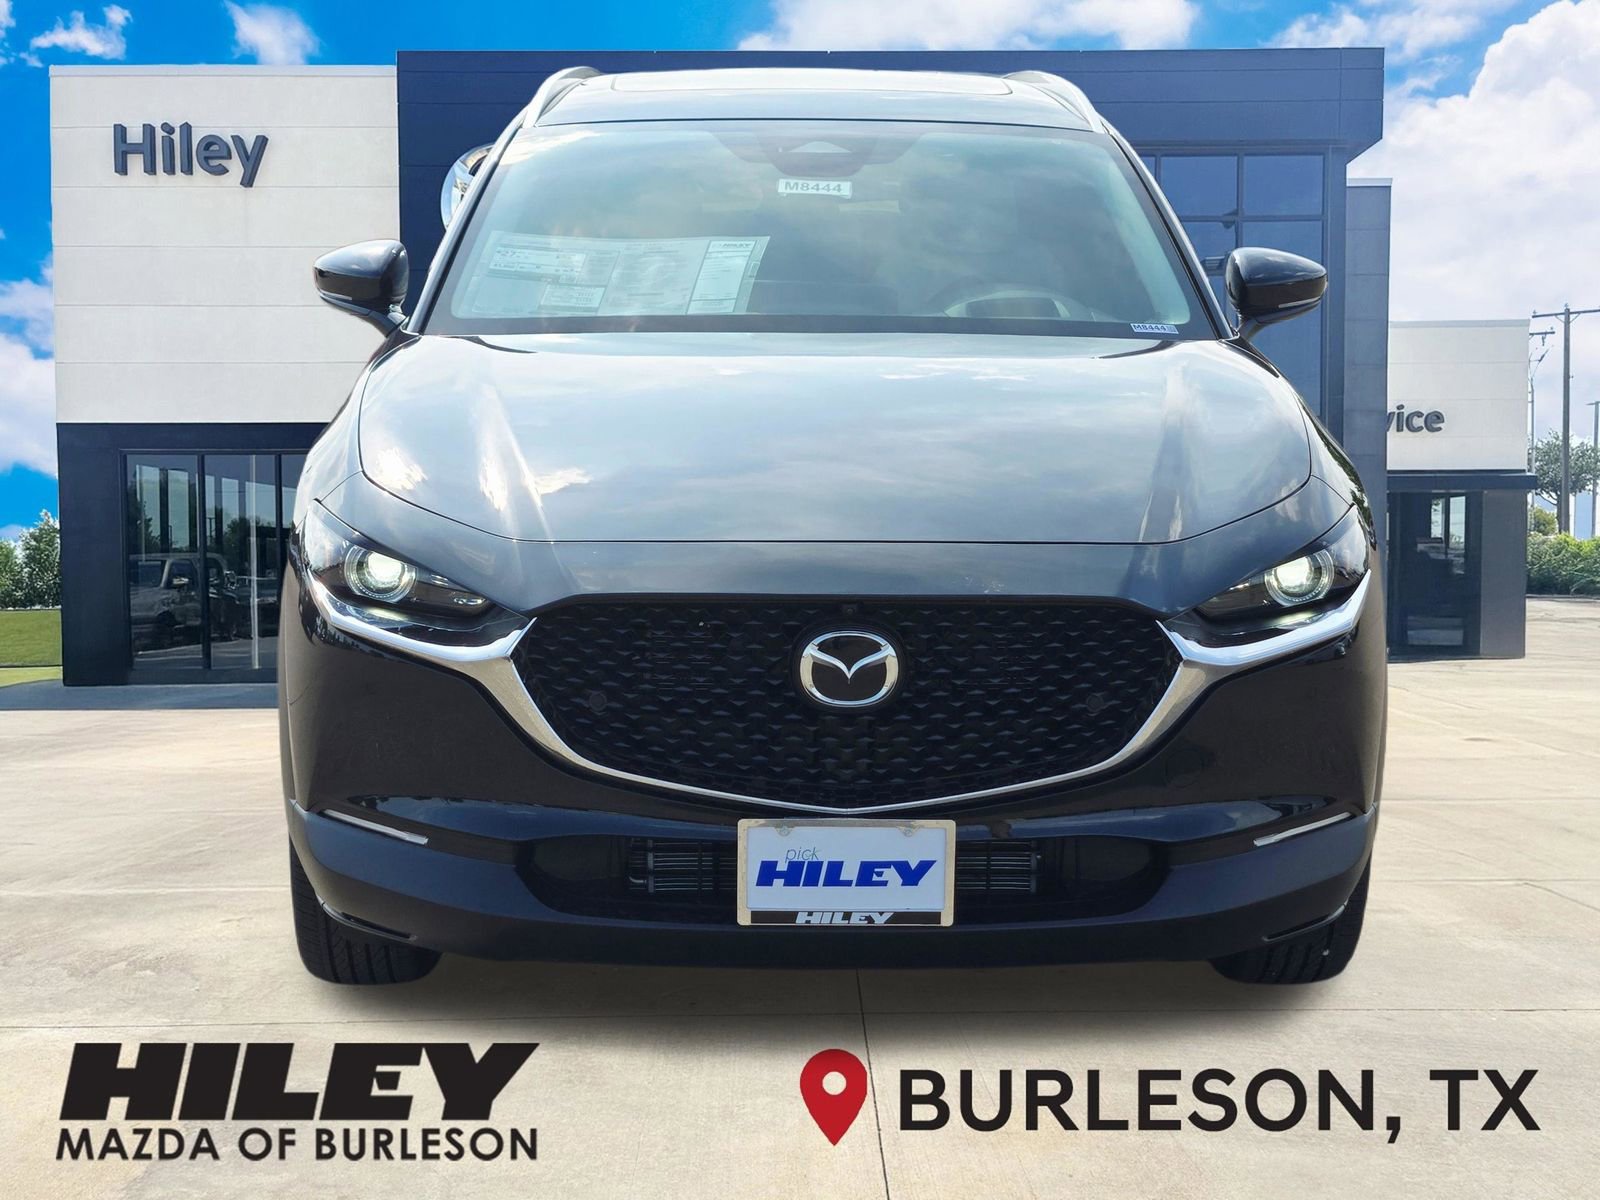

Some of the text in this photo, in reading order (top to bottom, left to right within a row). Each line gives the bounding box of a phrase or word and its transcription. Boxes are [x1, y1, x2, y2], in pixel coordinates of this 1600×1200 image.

[113, 121, 269, 188] Hiley
[784, 180, 843, 193] M8444
[785, 847, 820, 863] pick
[756, 860, 937, 886] HILEY
[795, 911, 894, 925] HILEY
